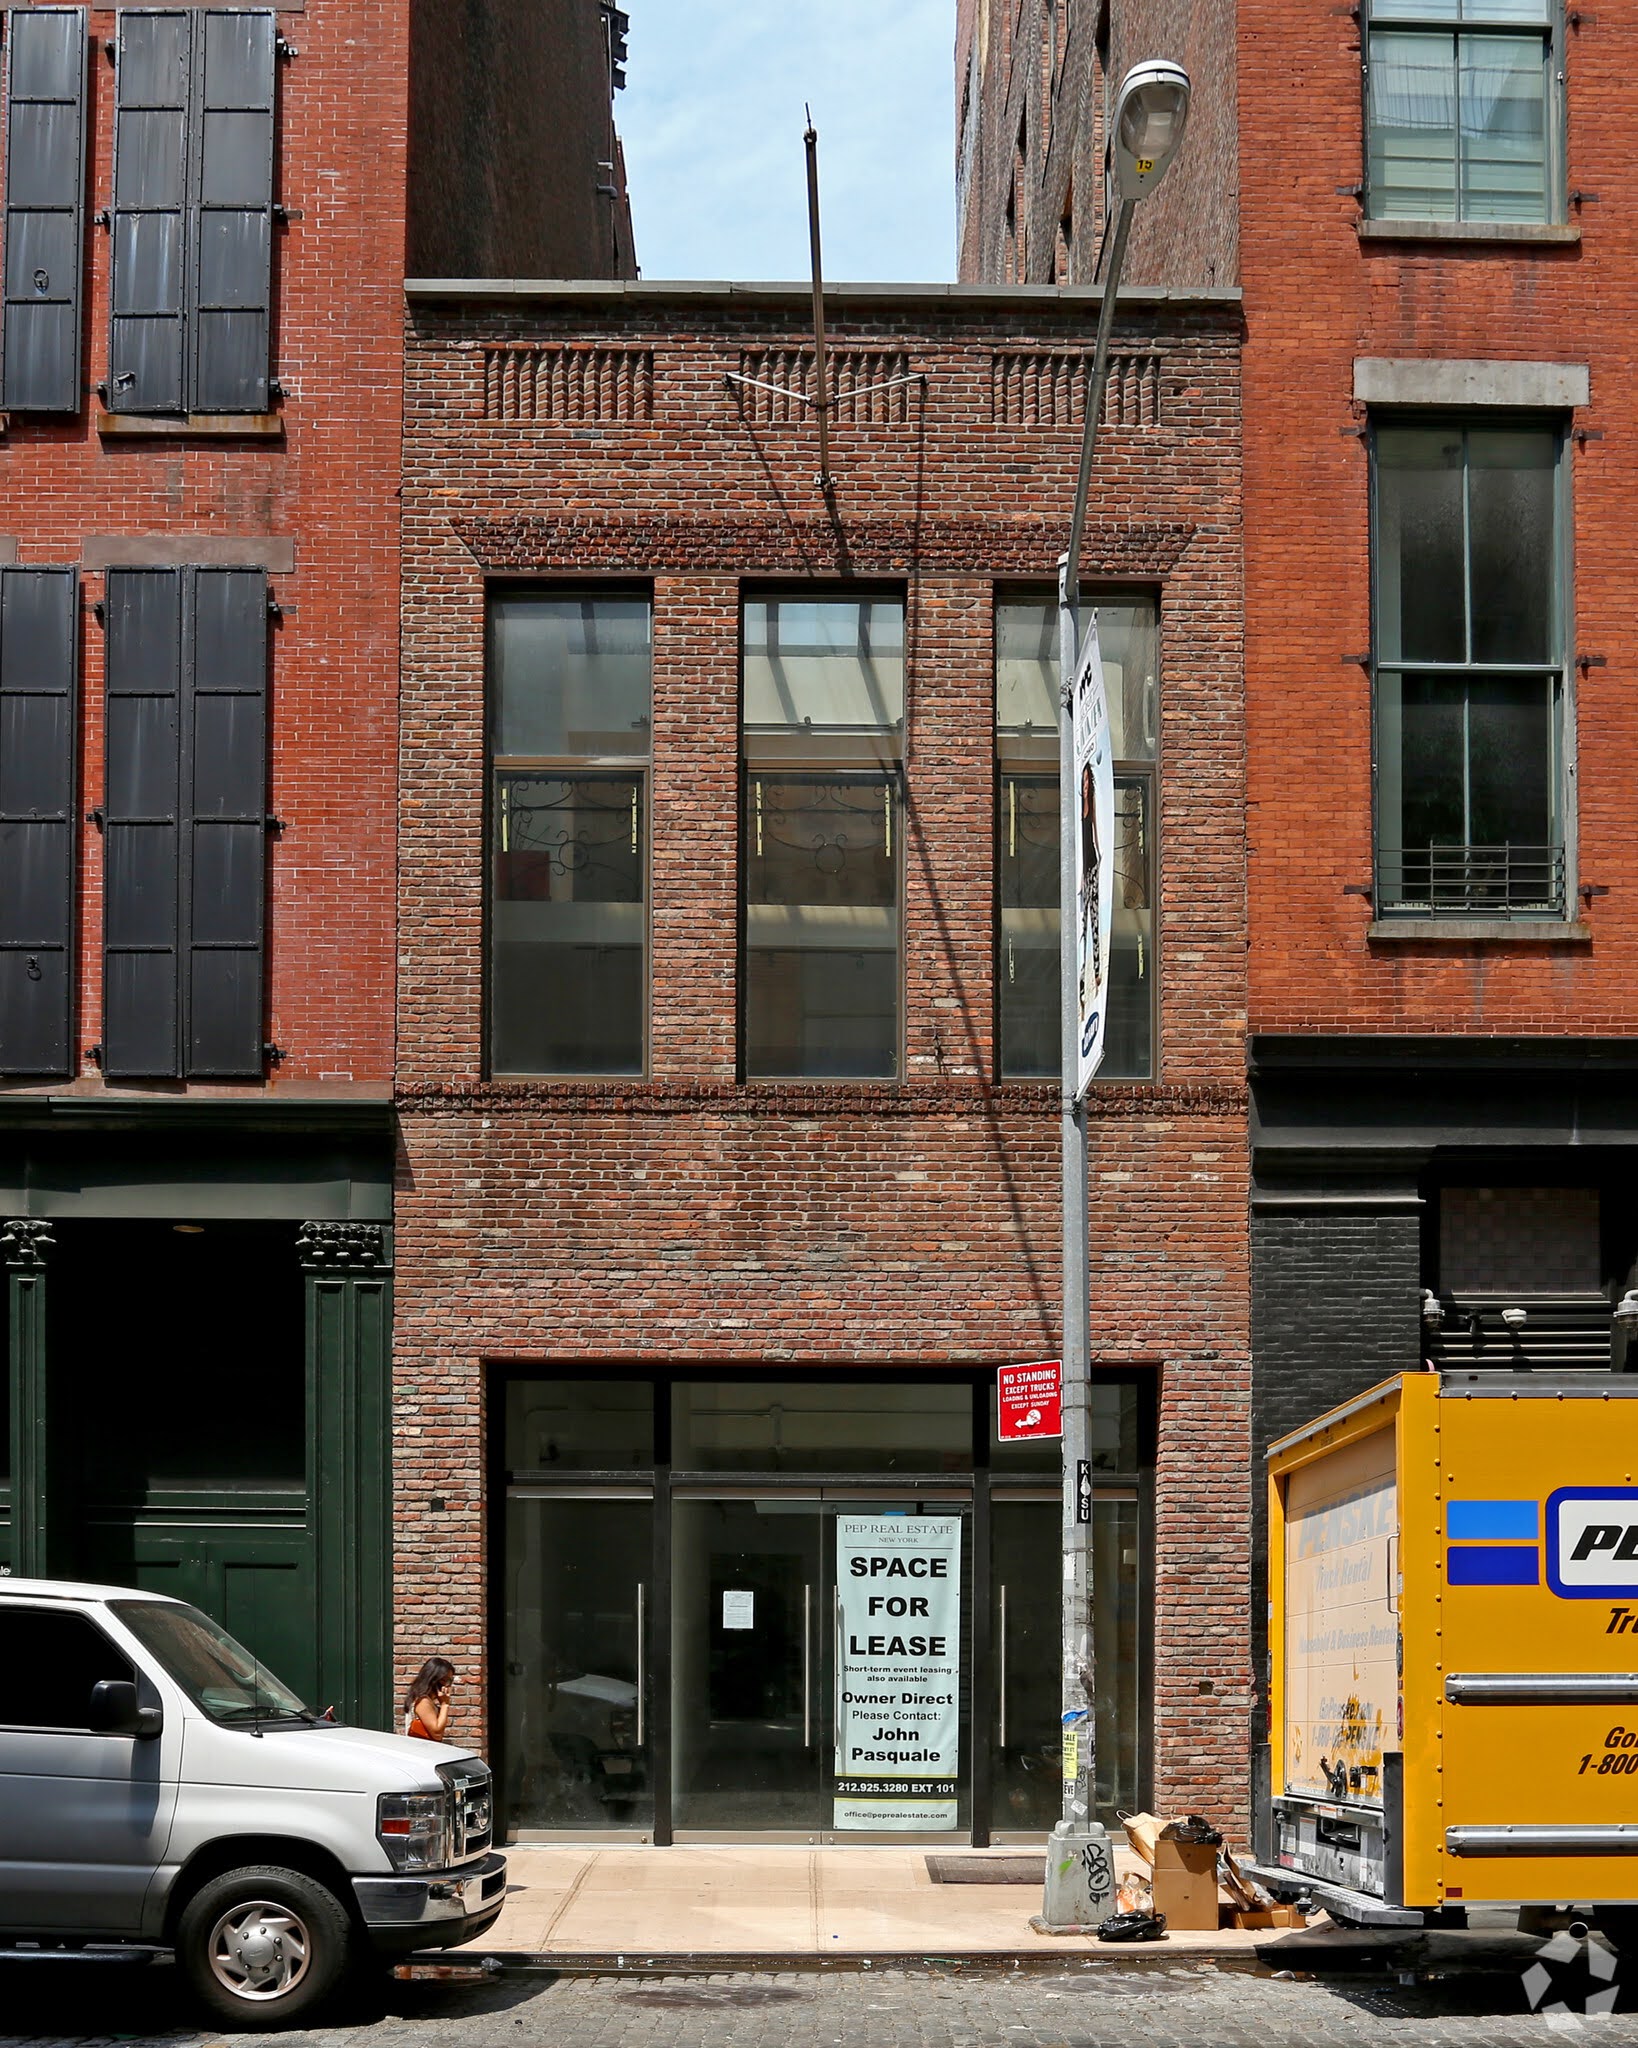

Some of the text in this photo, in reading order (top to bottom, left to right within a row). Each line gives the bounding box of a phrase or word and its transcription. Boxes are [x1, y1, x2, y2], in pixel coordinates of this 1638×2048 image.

[1137, 160, 1153, 170] 15
[1003, 1369, 1057, 1385] NO STANDING
[1005, 1382, 1055, 1395] EXCEPT TRUCKS
[1029, 1391, 1058, 1400] UNLOADING
[1011, 1400, 1050, 1410] EXCEPT SUNDAY
[844, 1524, 953, 1535] PEP REAL ESTATE
[850, 1557, 948, 1578] SPACE
[1340, 1552, 1373, 1587] Rental
[868, 1597, 930, 1617] FOR
[850, 1636, 947, 1657] LEASE
[843, 1665, 891, 1673] Short-term
[920, 1666, 952, 1675] leasing
[888, 1675, 928, 1683] available
[841, 1691, 953, 1705] Owner Direct
[852, 1711, 941, 1721] Please Contact:
[872, 1728, 920, 1741] John
[1604, 1726, 1638, 1748] Go
[851, 1747, 941, 1764] Pasquale
[838, 1782, 955, 1793] 212.925.3280 EXT 101
[844, 1811, 948, 1819] office@peprealestate.com
